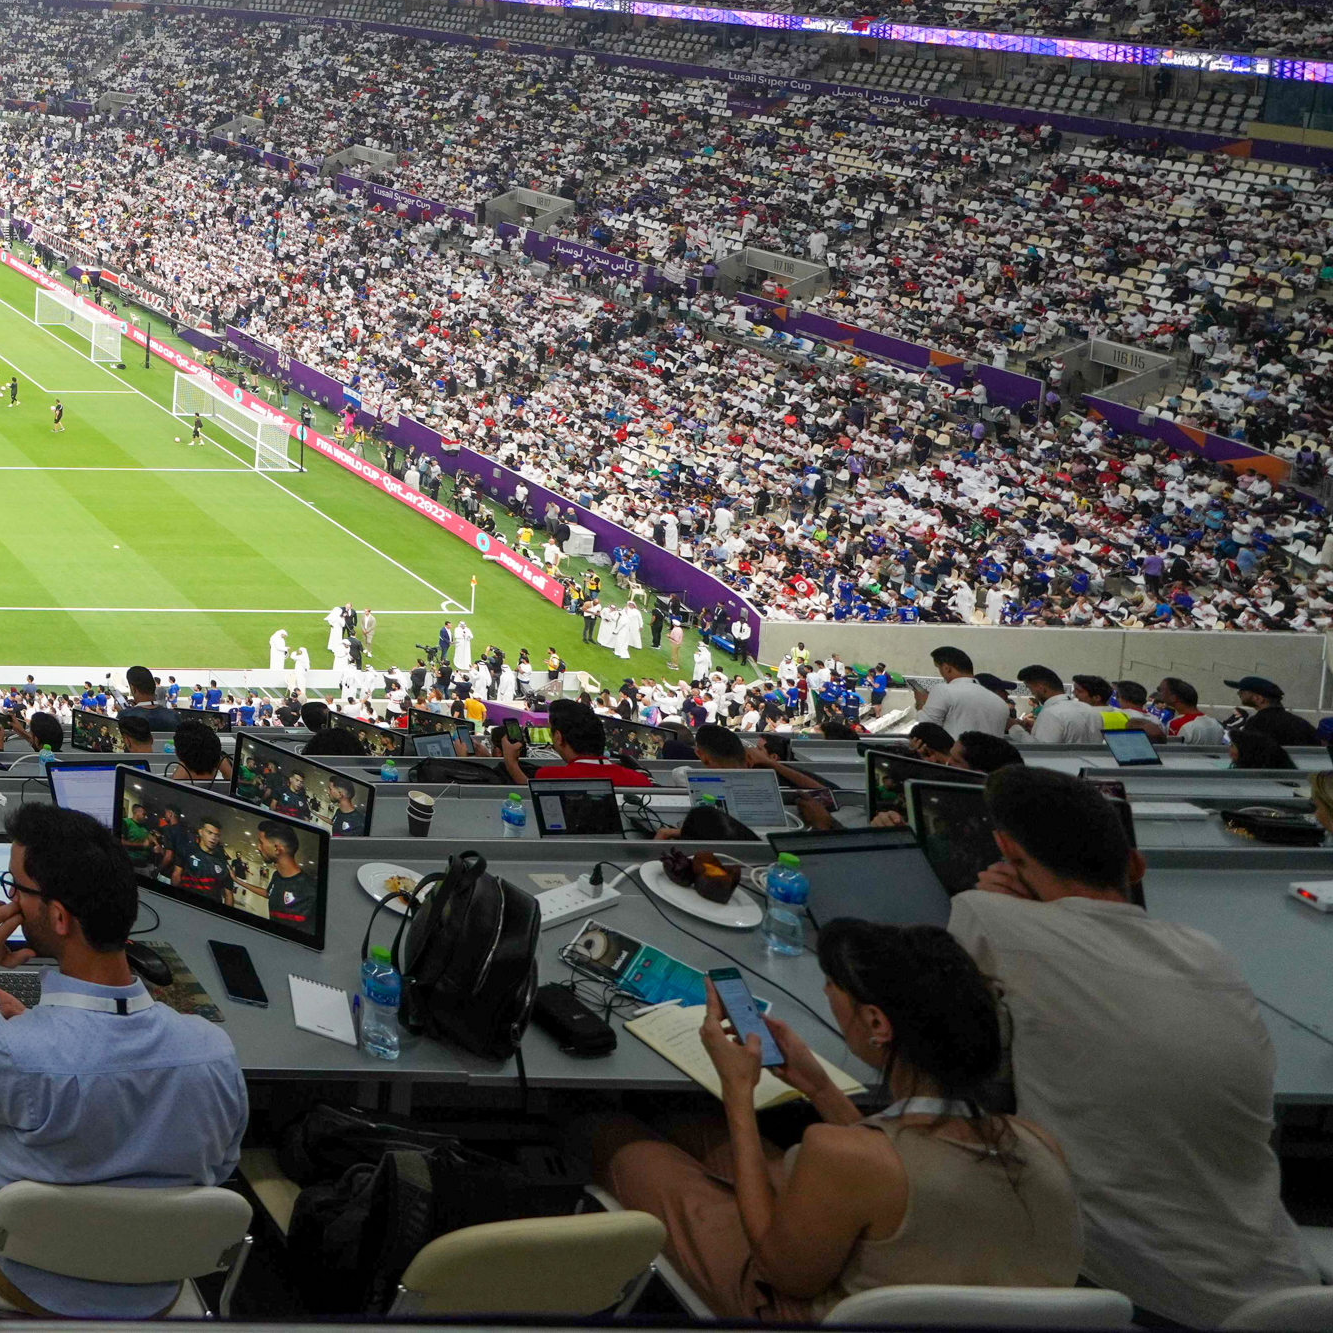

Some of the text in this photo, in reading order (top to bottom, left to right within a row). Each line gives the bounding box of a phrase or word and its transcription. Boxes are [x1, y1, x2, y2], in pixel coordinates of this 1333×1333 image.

[728, 72, 757, 82] Lusail
[790, 80, 812, 92] Cup
[373, 186, 393, 200] Lusail
[416, 199, 431, 210] Cup
[774, 259, 794, 274] 117 116
[133, 330, 145, 342] FIFA
[163, 349, 174, 359] CUP
[1113, 349, 1145, 369] 116 115
[316, 437, 334, 455] FIFA
[333, 446, 362, 471] WORLD
[363, 464, 380, 481] CUP
[499, 552, 523, 573] now
[522, 565, 533, 580] is
